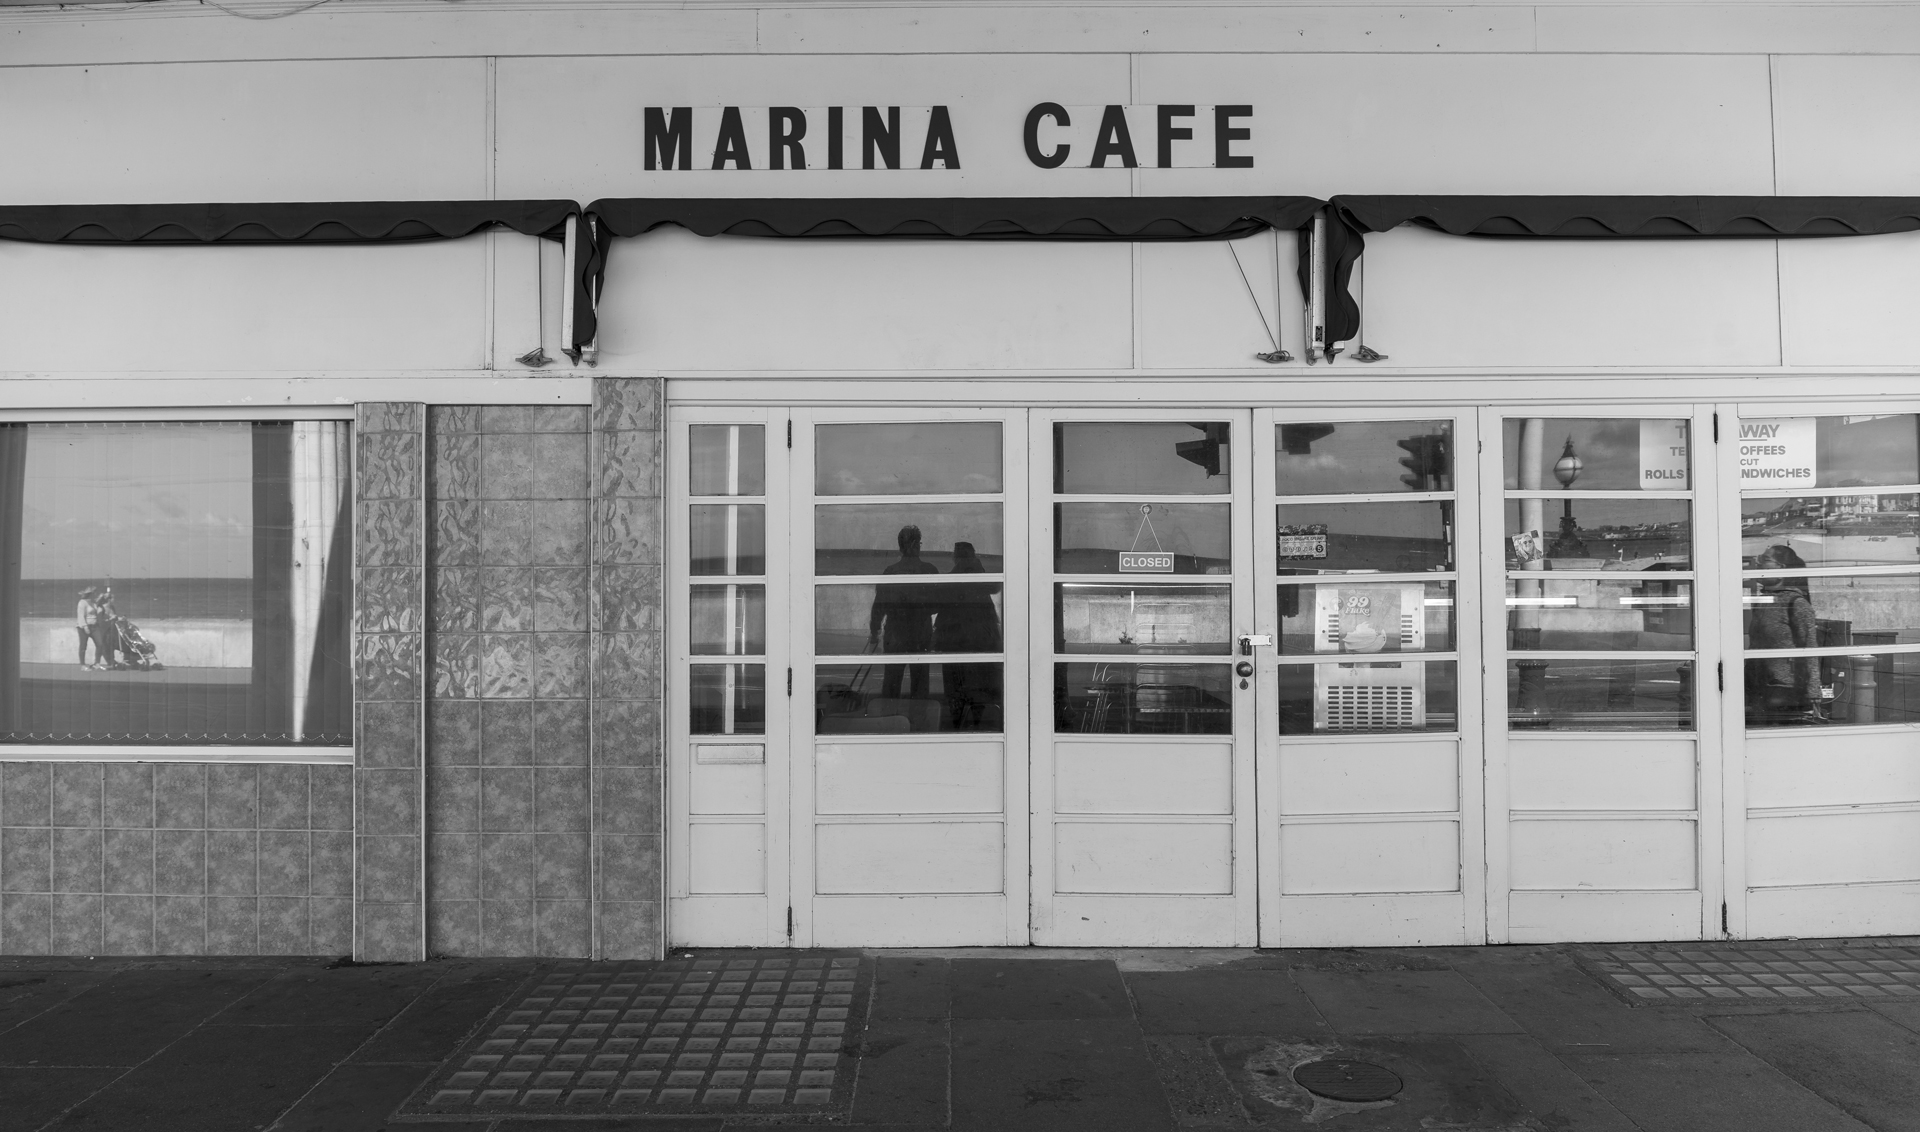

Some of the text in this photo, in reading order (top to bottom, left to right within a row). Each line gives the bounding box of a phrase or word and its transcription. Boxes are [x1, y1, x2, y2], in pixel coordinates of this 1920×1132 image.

[643, 102, 1255, 170] MARINA CAFE
[1669, 445, 1786, 457] TE OFFEES
[1739, 458, 1760, 466] CUT
[1645, 468, 1811, 480] ROLLS NDWICHES
[1122, 557, 1171, 568] CLOSED
[1346, 596, 1370, 608] 99
[1344, 607, 1371, 617] Flake
